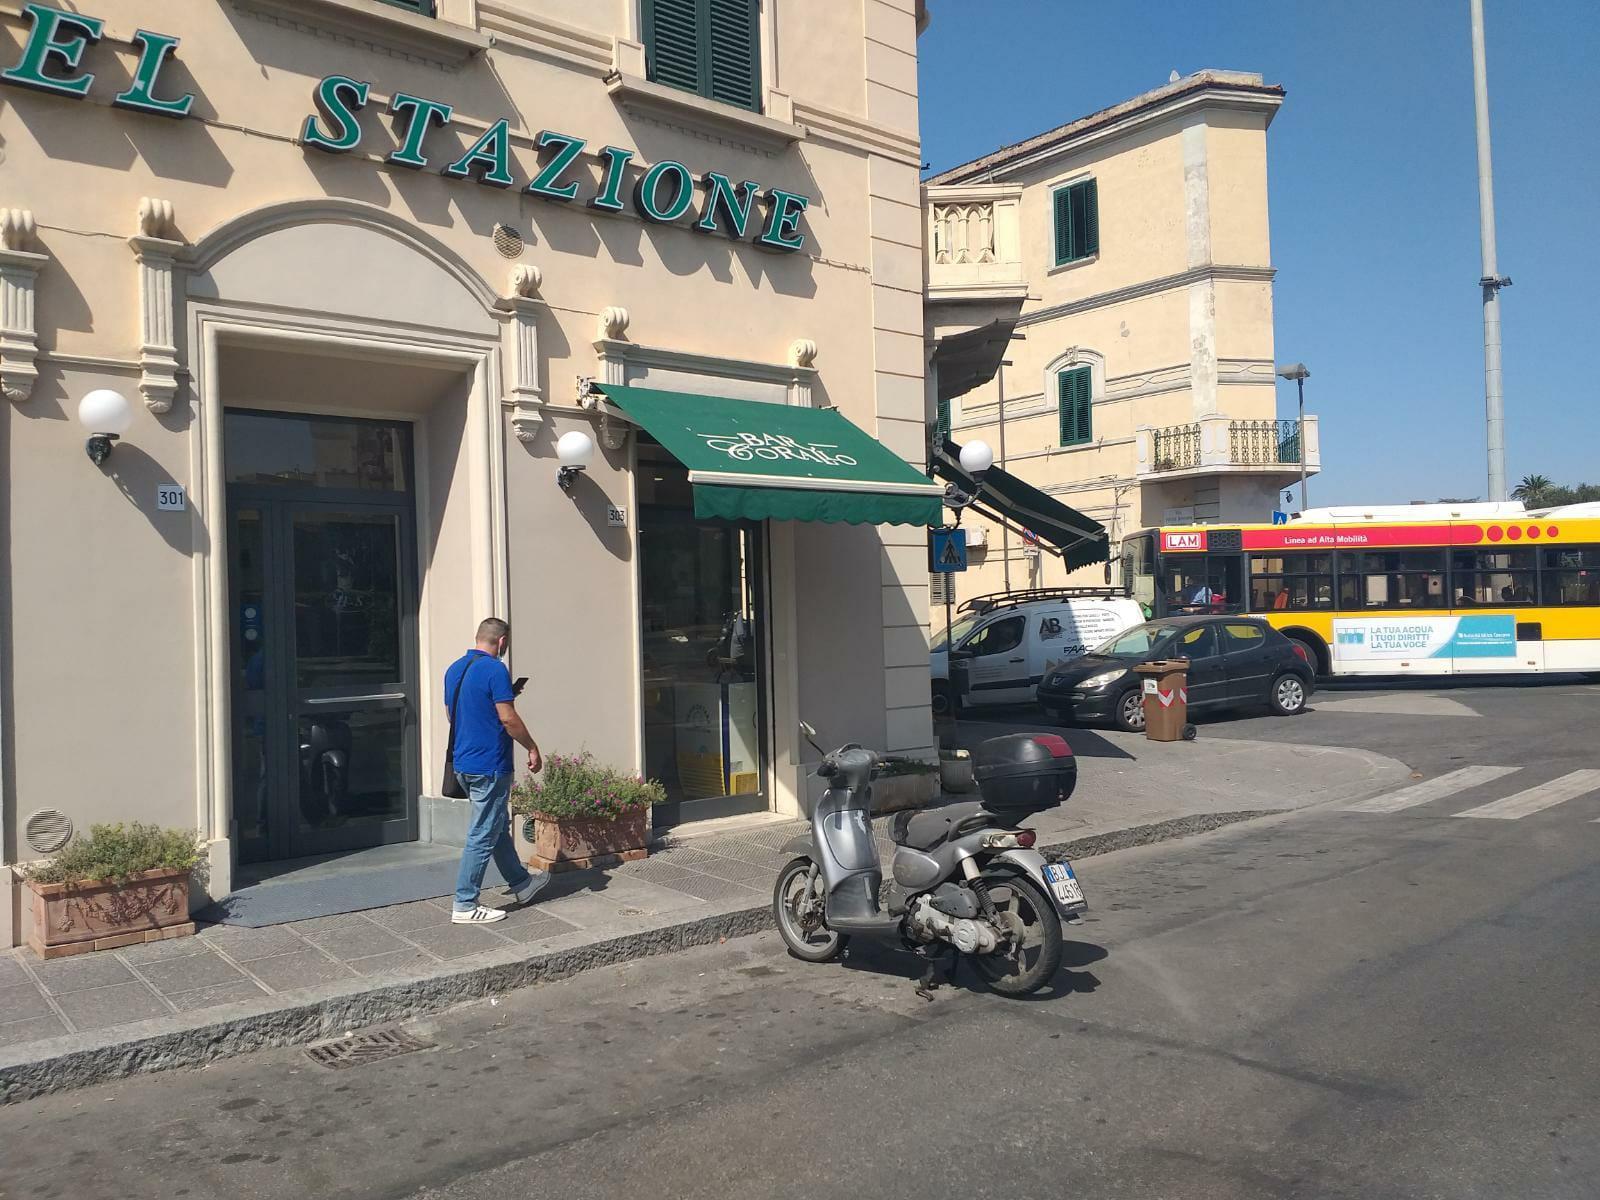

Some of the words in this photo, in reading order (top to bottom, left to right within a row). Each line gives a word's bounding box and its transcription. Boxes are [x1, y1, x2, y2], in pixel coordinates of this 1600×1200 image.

[1, 3, 194, 117] EL
[304, 74, 808, 252] STAZIONE
[737, 432, 803, 449] BAR
[706, 440, 858, 466] CORALLO
[160, 491, 183, 505] 301
[609, 509, 625, 522] 303
[1169, 535, 1198, 547] LAM
[1284, 536, 1306, 545] Linea
[1307, 536, 1317, 544] ad
[1319, 535, 1335, 544] Alta
[1336, 534, 1368, 543] Mobilità
[1039, 616, 1062, 634] AB
[1384, 626, 1401, 634] TUA
[1402, 625, 1434, 633] ACQUA
[1375, 634, 1396, 642] TUOI
[1398, 633, 1430, 641] DIRITTI
[1063, 644, 1095, 655] FAAC
[1371, 641, 1382, 649] LA
[1402, 640, 1427, 648] VOCE
[1051, 865, 1065, 881] BJ
